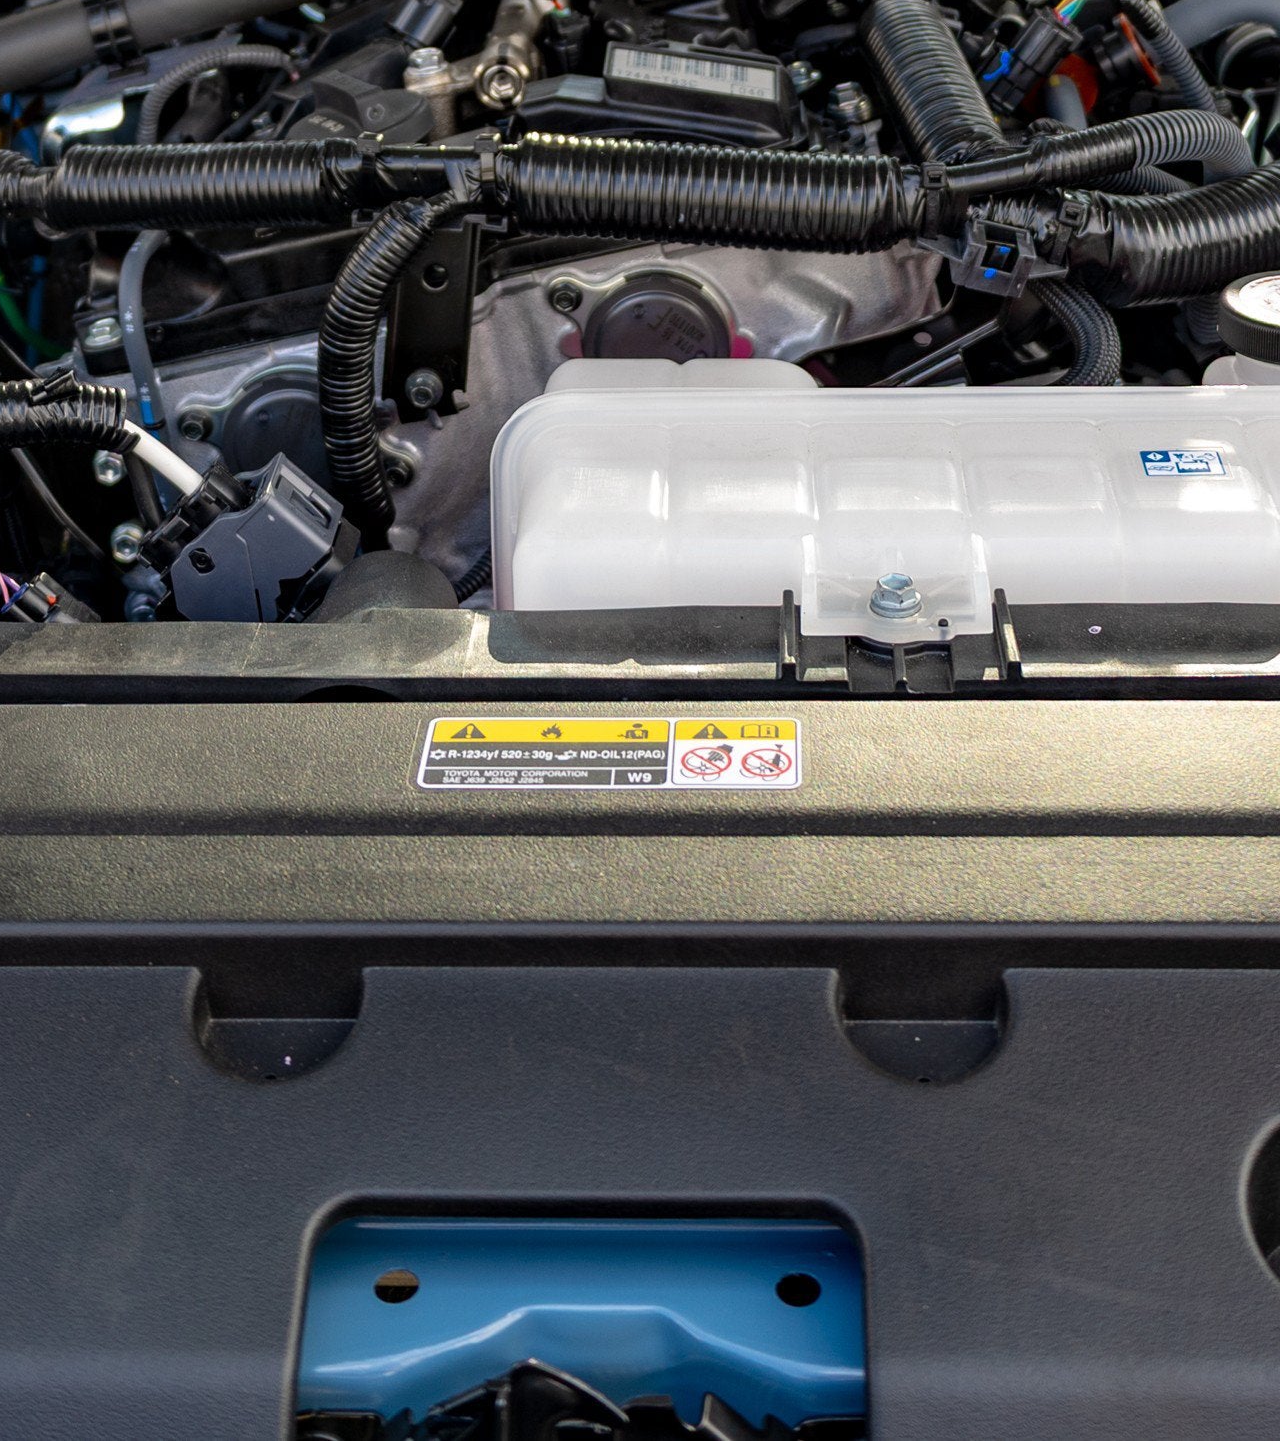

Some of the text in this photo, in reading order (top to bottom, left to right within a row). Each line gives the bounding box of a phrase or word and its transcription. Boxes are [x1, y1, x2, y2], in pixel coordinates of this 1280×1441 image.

[447, 749, 499, 760] R-1234yf
[580, 749, 665, 760] ND-OIL12(PAG)
[627, 772, 652, 783] W9
